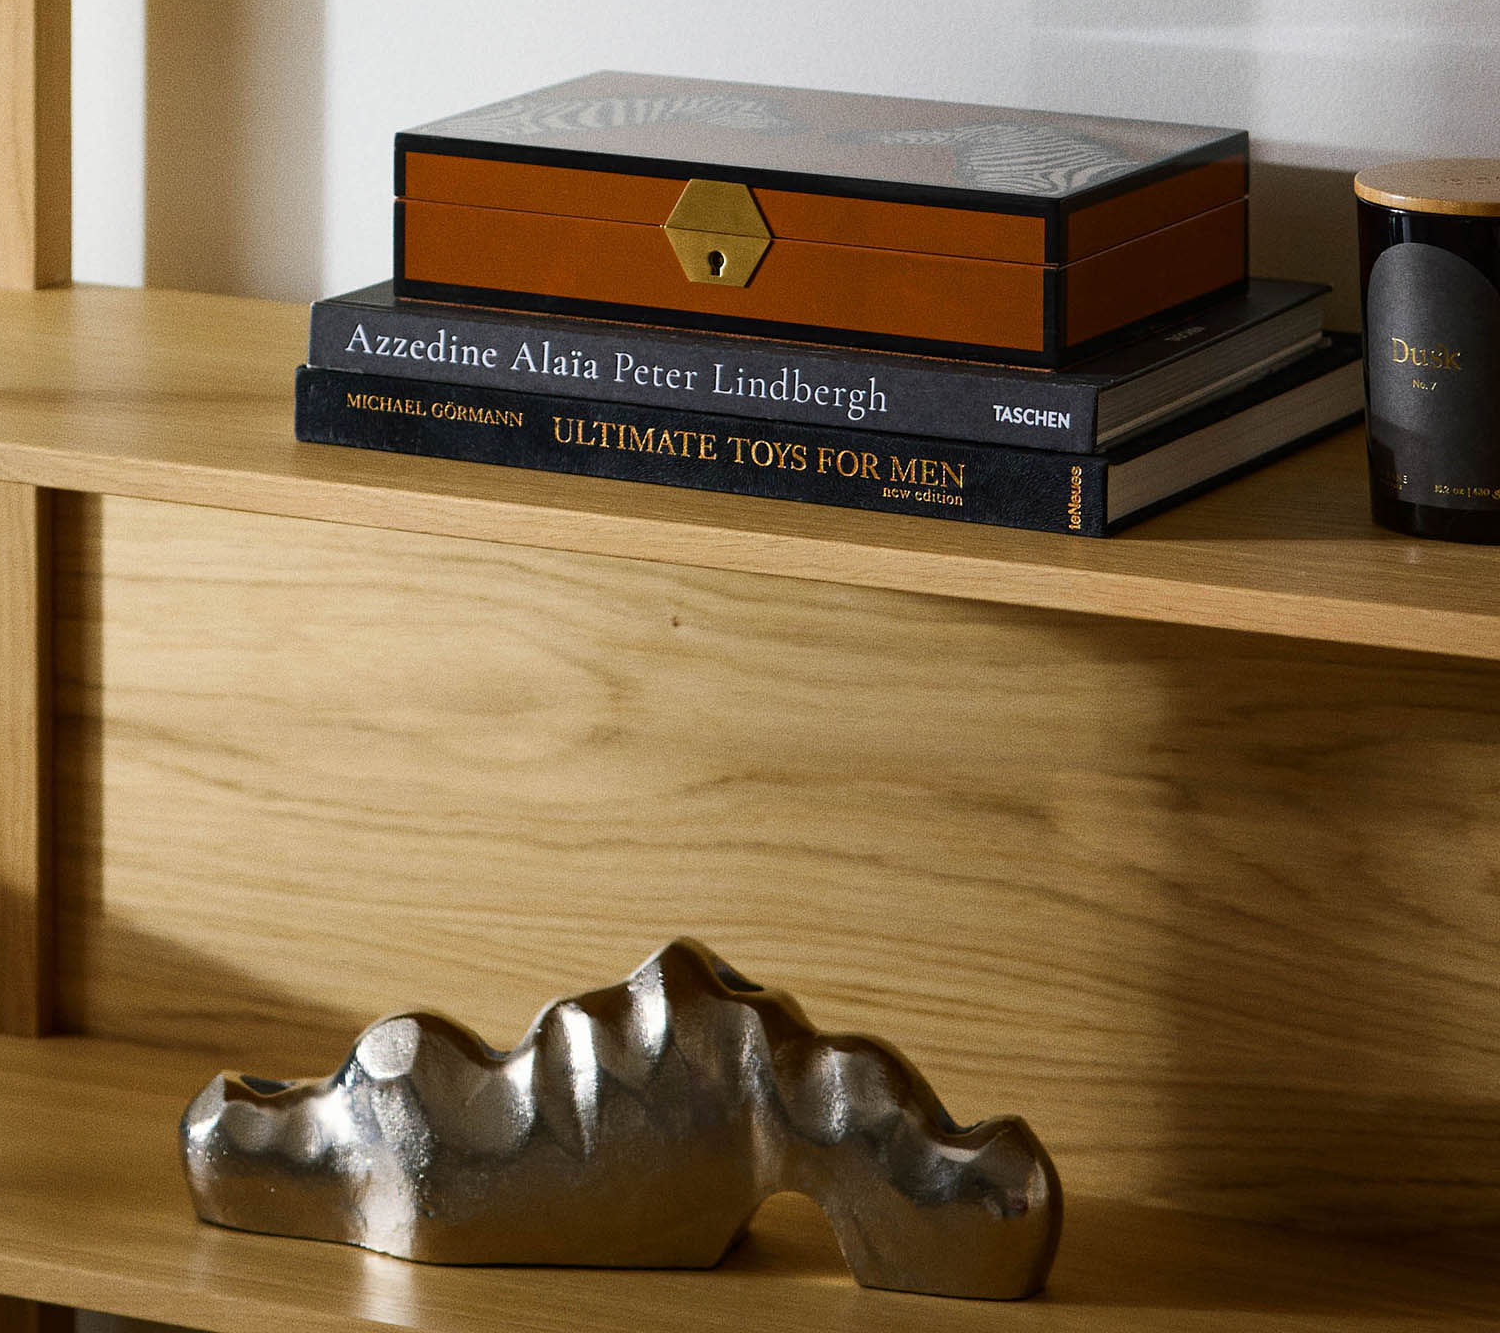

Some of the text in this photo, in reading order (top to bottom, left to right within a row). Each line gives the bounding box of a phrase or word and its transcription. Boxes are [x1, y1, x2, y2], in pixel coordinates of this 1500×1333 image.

[1391, 337, 1461, 371] Dusk
[345, 324, 888, 421] Azzedine Alaïa Peter Lindbergh
[347, 392, 523, 427] MICHAEL GÖRMANN
[993, 404, 1071, 430] TASCHEN
[553, 416, 965, 489] ULTIMATE TOYS FOR MEN
[882, 486, 964, 507] new edition
[1068, 465, 1083, 531] teNeues
